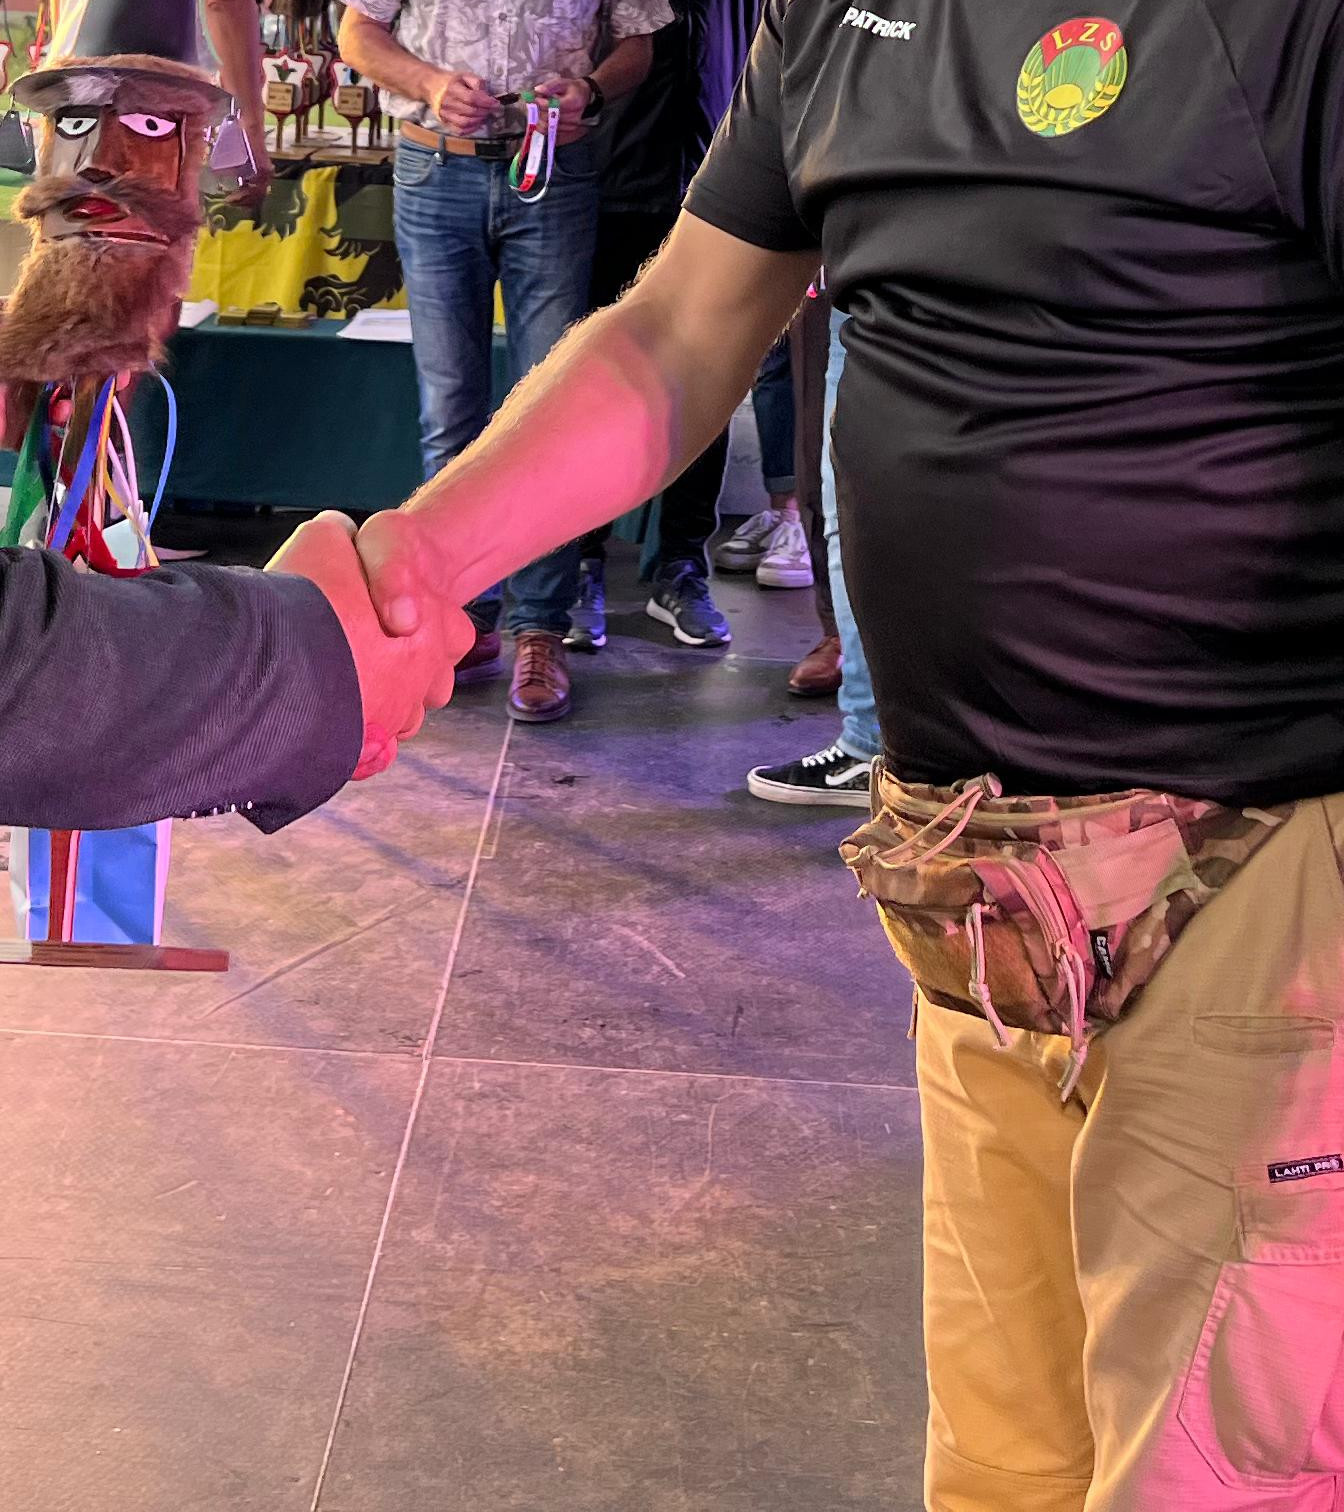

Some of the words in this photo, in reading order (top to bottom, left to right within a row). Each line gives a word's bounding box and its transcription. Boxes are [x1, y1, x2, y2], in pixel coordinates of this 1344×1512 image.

[839, 6, 917, 41] PATRICK
[1051, 22, 1118, 52] LZS
[1274, 1163, 1310, 1178] LAHTI
